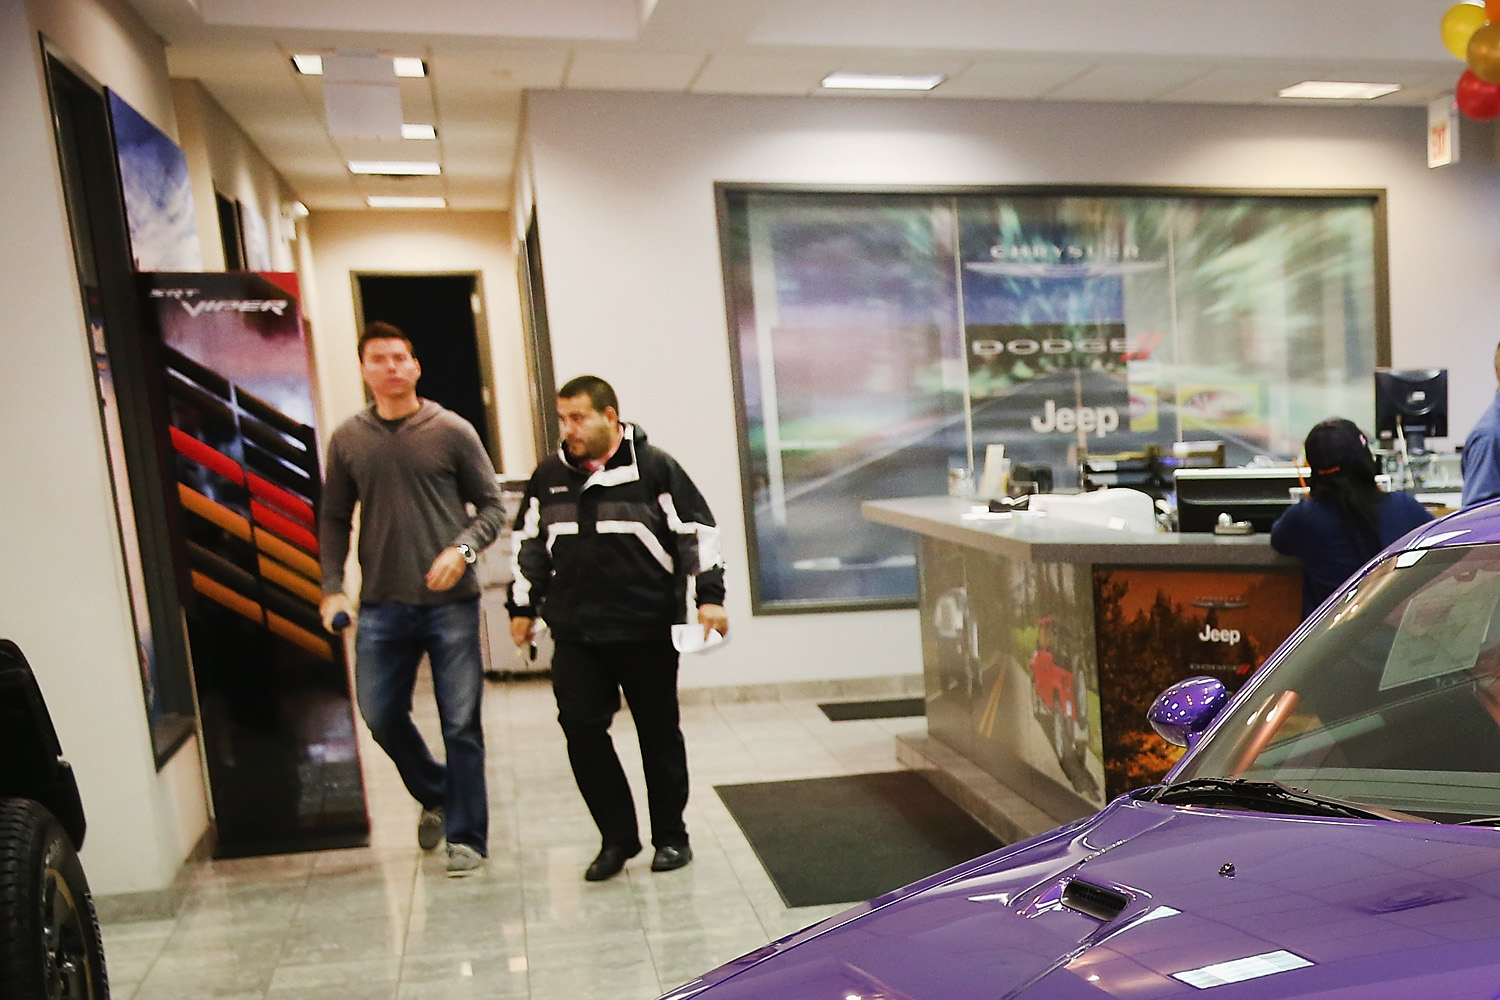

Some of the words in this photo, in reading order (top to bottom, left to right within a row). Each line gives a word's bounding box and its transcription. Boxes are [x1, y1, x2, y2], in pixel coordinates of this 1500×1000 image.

[181, 300, 288, 317] VIPER
[1031, 400, 1119, 438] Jeep
[1199, 624, 1241, 646] Jeep
